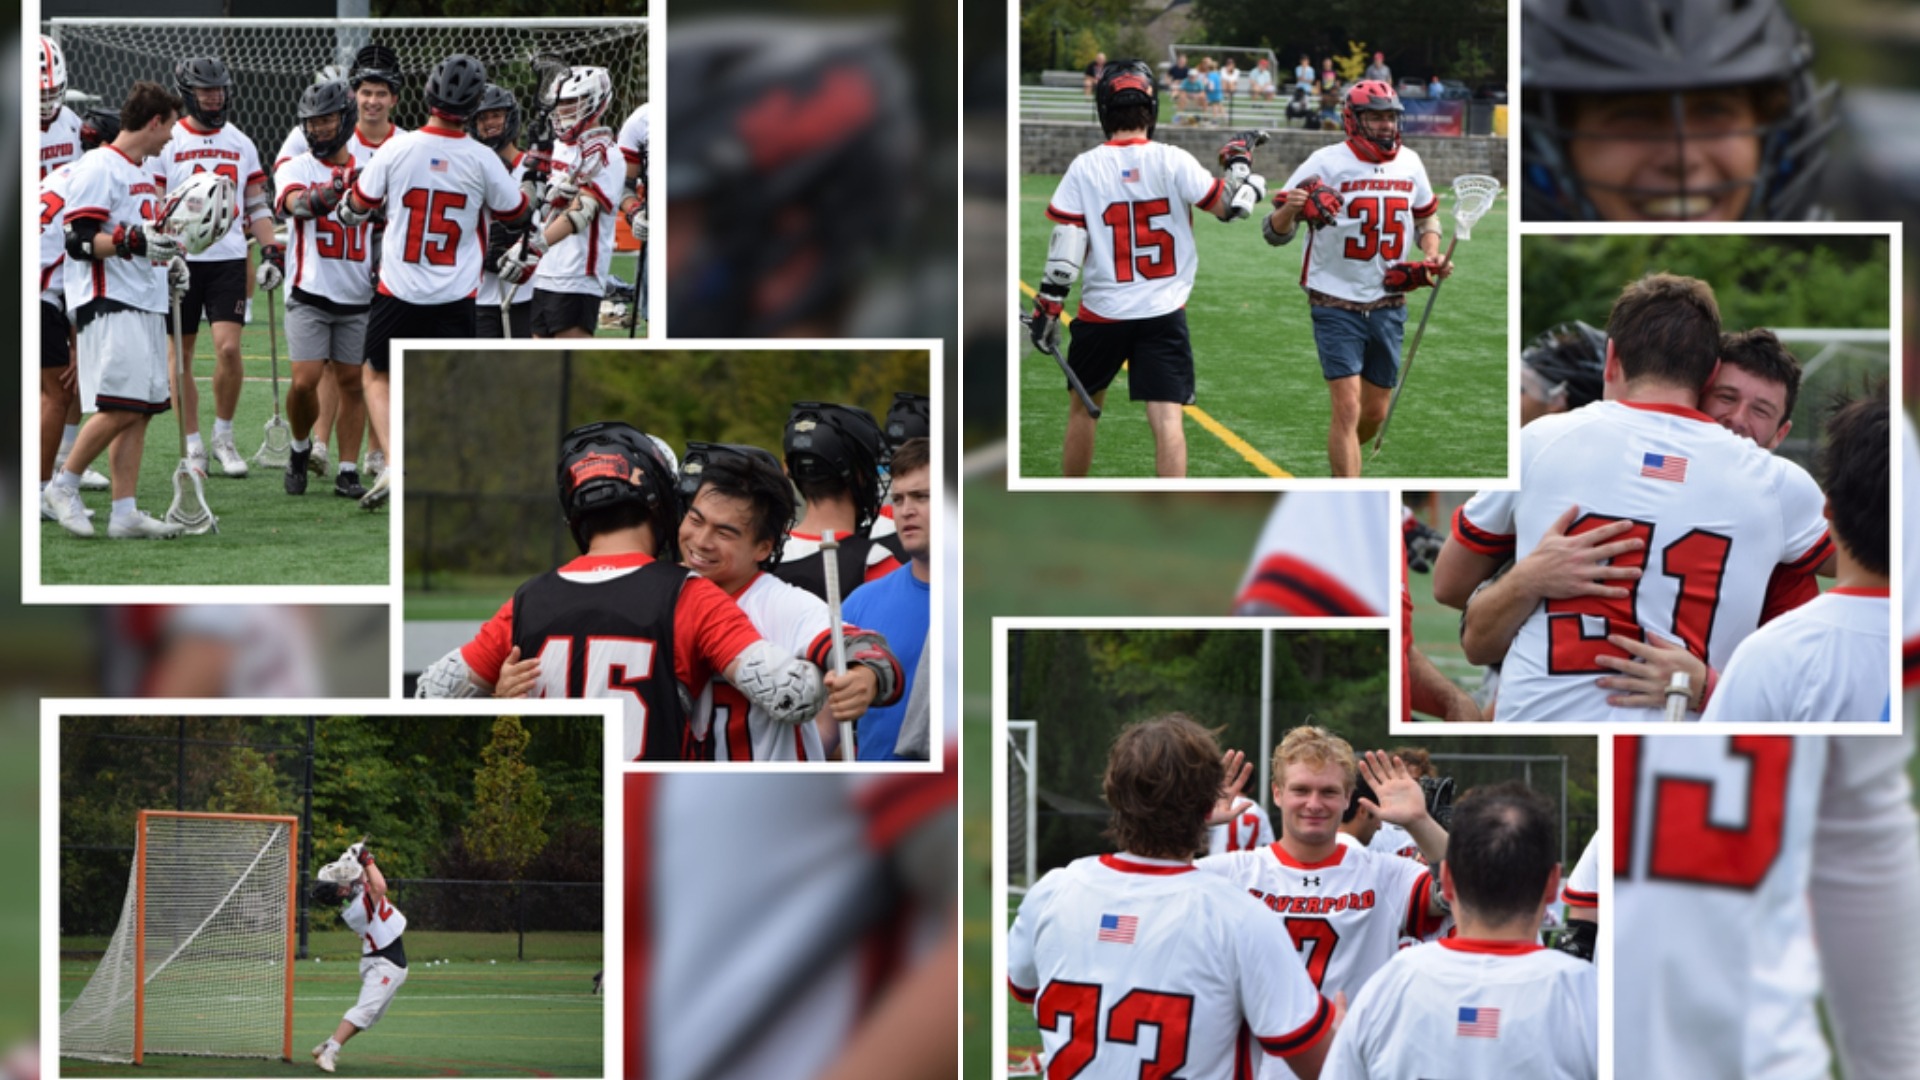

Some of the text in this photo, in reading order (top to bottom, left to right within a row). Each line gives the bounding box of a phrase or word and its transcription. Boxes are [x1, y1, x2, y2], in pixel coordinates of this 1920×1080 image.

[316, 212, 366, 262] 50
[402, 187, 468, 266] 15
[1101, 197, 1177, 283] 15
[1343, 196, 1408, 261] 35
[1284, 916, 1340, 990] 7
[1037, 978, 1195, 1080] 23
